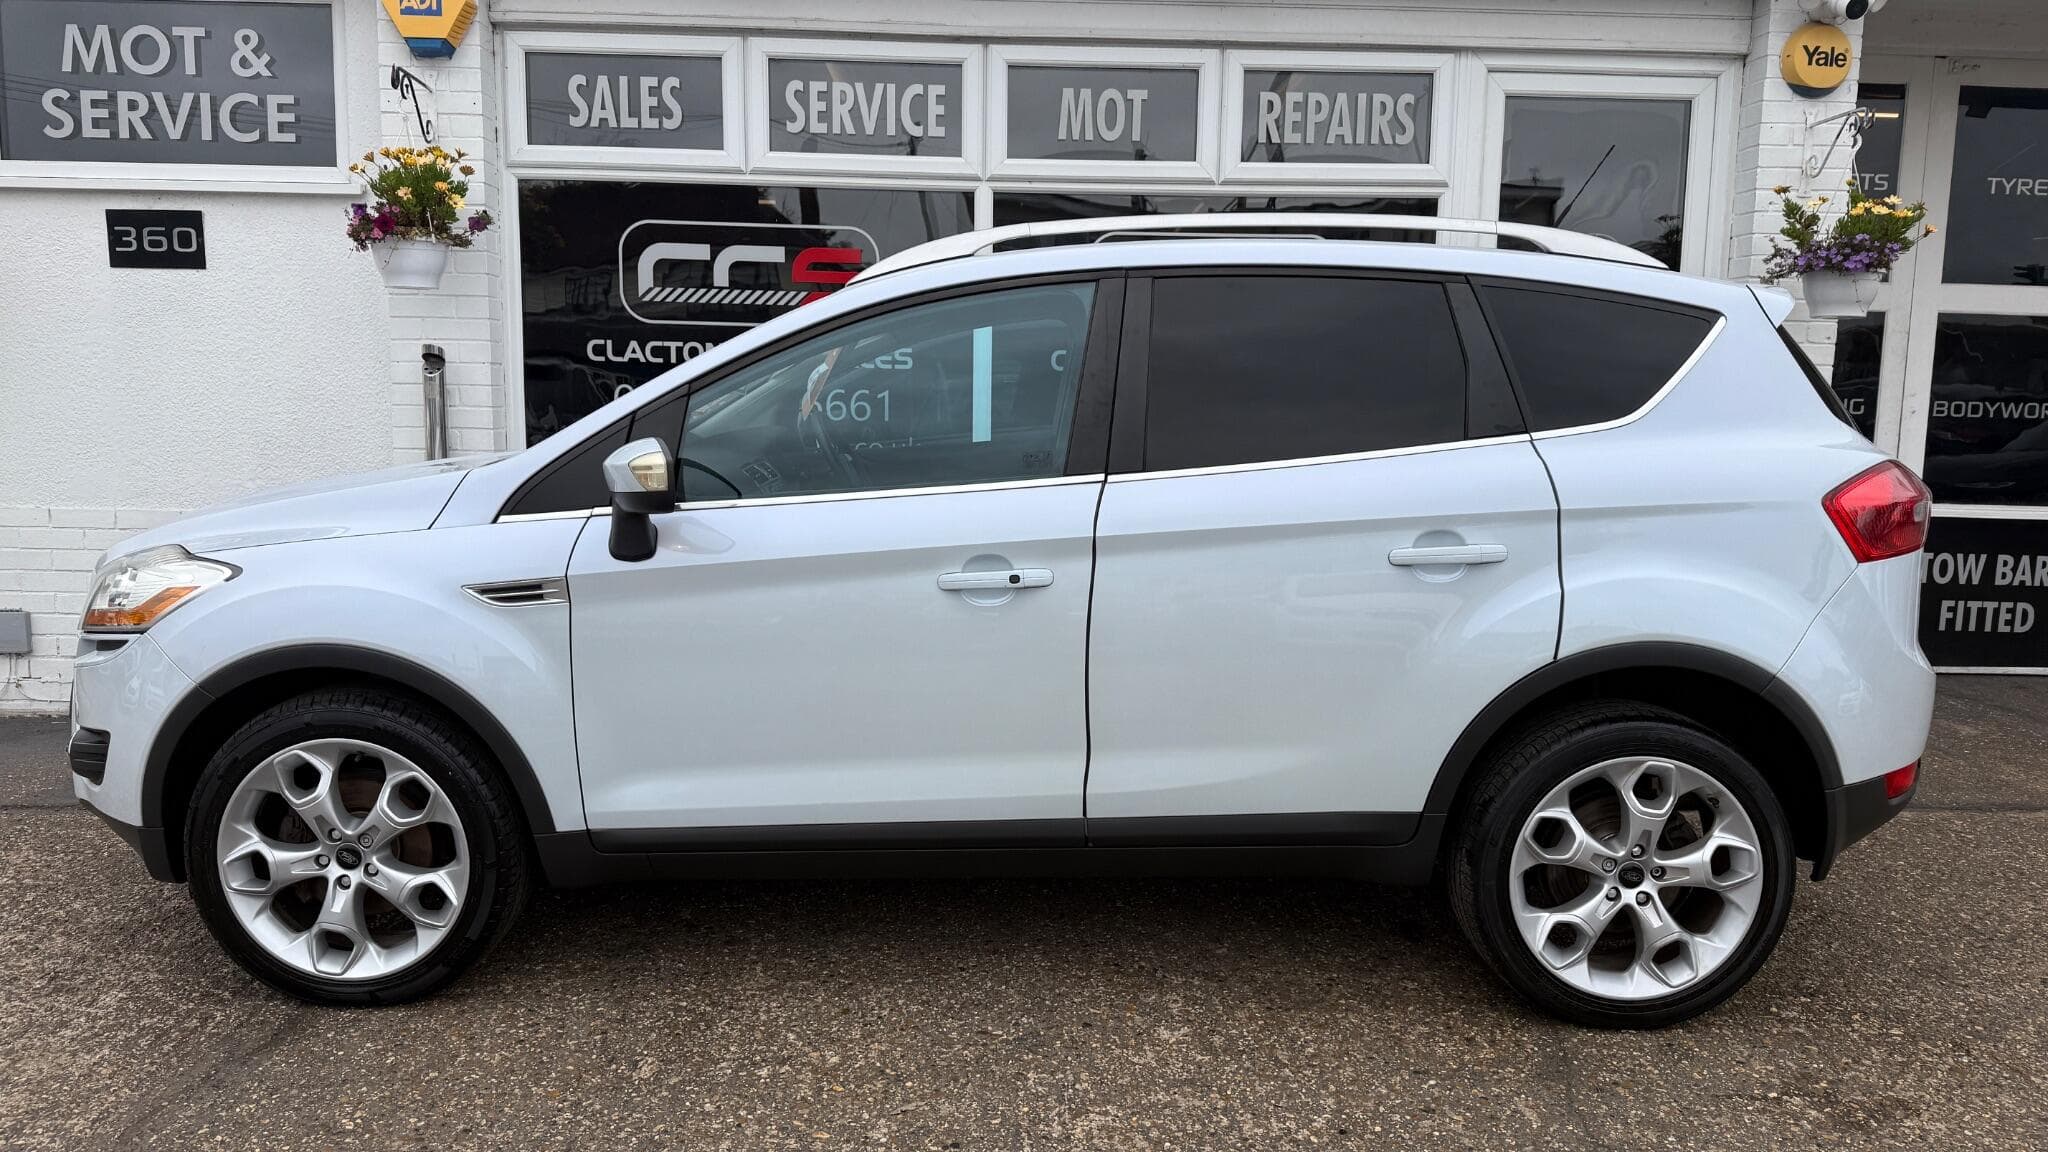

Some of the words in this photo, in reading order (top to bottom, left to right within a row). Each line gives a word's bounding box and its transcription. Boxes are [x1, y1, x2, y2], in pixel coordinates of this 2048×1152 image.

[62, 24, 206, 76] MOT
[230, 28, 273, 77] &
[1802, 44, 1848, 68] Yale
[41, 88, 297, 143] SERVICE
[568, 74, 683, 130] SALES
[785, 79, 946, 138] SERVICE
[1057, 87, 1148, 142] MOT
[1257, 91, 1415, 145] REPAIRS
[113, 226, 198, 252] 360
[587, 339, 722, 363] CLACTO
[1920, 552, 1987, 585] TOW
[1994, 554, 2048, 587] BAR
[1938, 600, 2035, 633] FITTED
